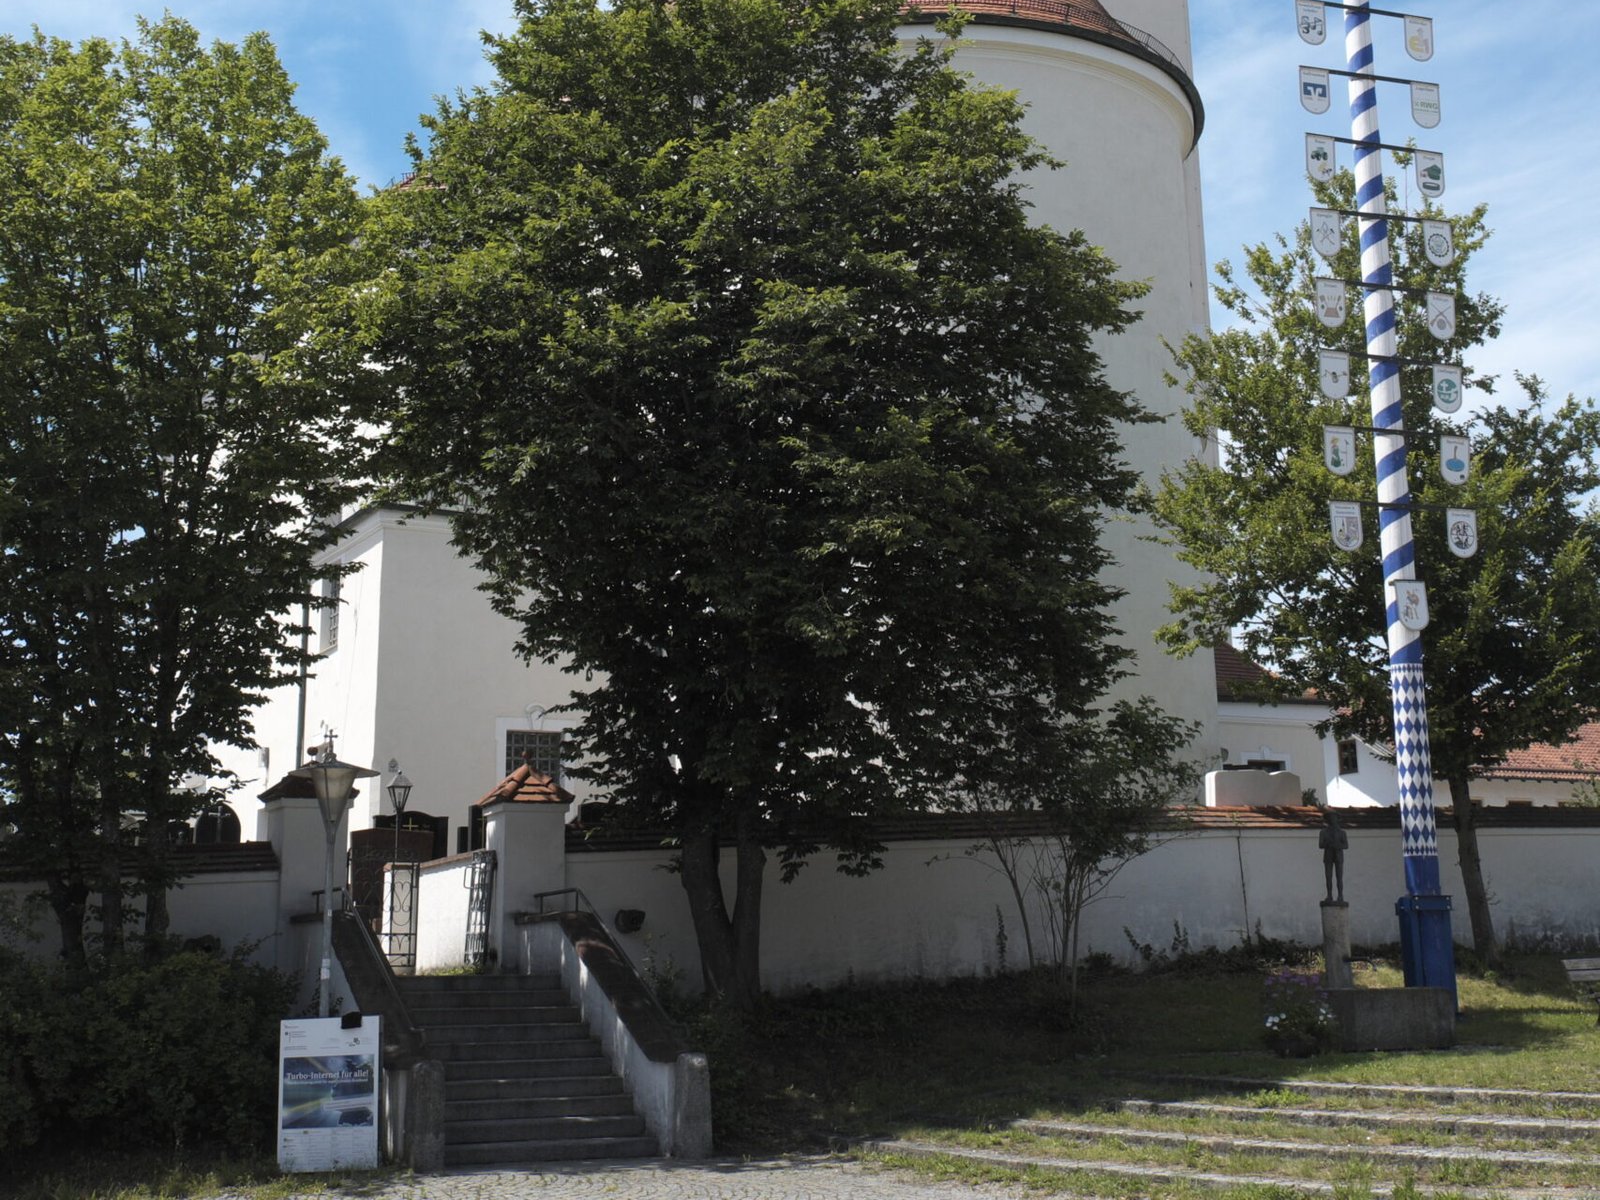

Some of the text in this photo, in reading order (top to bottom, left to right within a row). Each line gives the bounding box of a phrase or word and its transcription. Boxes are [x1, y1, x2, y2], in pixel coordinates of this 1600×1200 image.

[287, 1068, 369, 1080] Turbo-Internet für alle!
